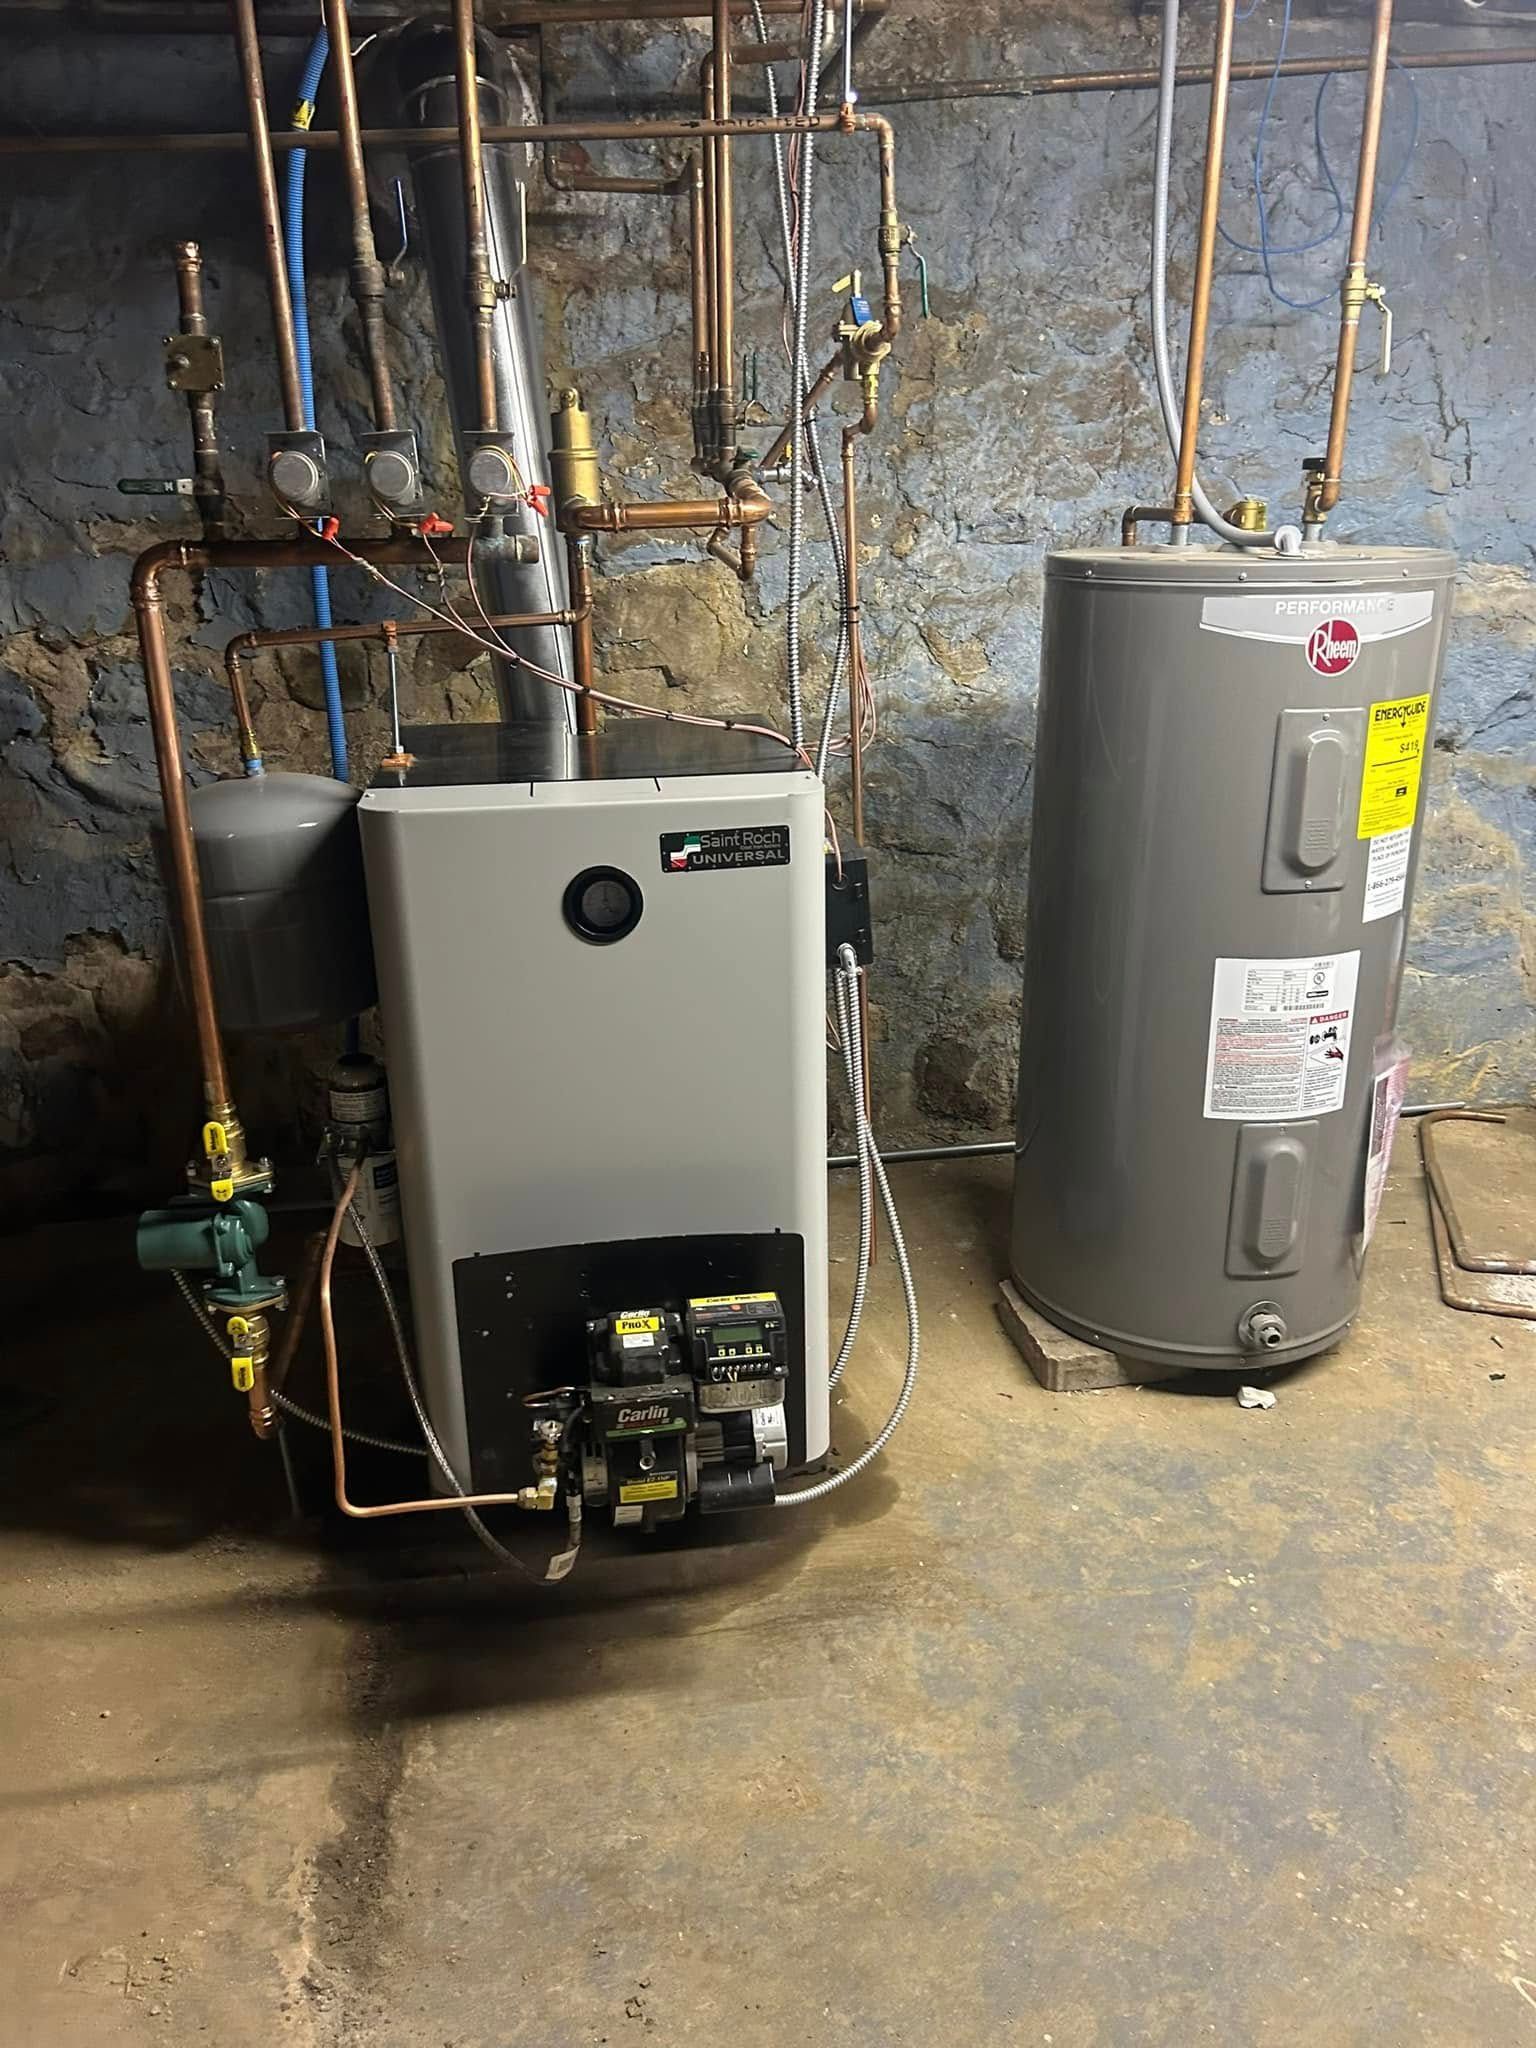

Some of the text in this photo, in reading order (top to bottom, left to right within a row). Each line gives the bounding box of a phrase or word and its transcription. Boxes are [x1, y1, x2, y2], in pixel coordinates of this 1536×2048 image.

[776, 116, 821, 128] FEED
[1312, 620, 1358, 667] Rheem
[700, 831, 781, 848] Saint Roch
[692, 849, 786, 865] UNIVERSAL
[617, 1405, 669, 1423] Carlin
